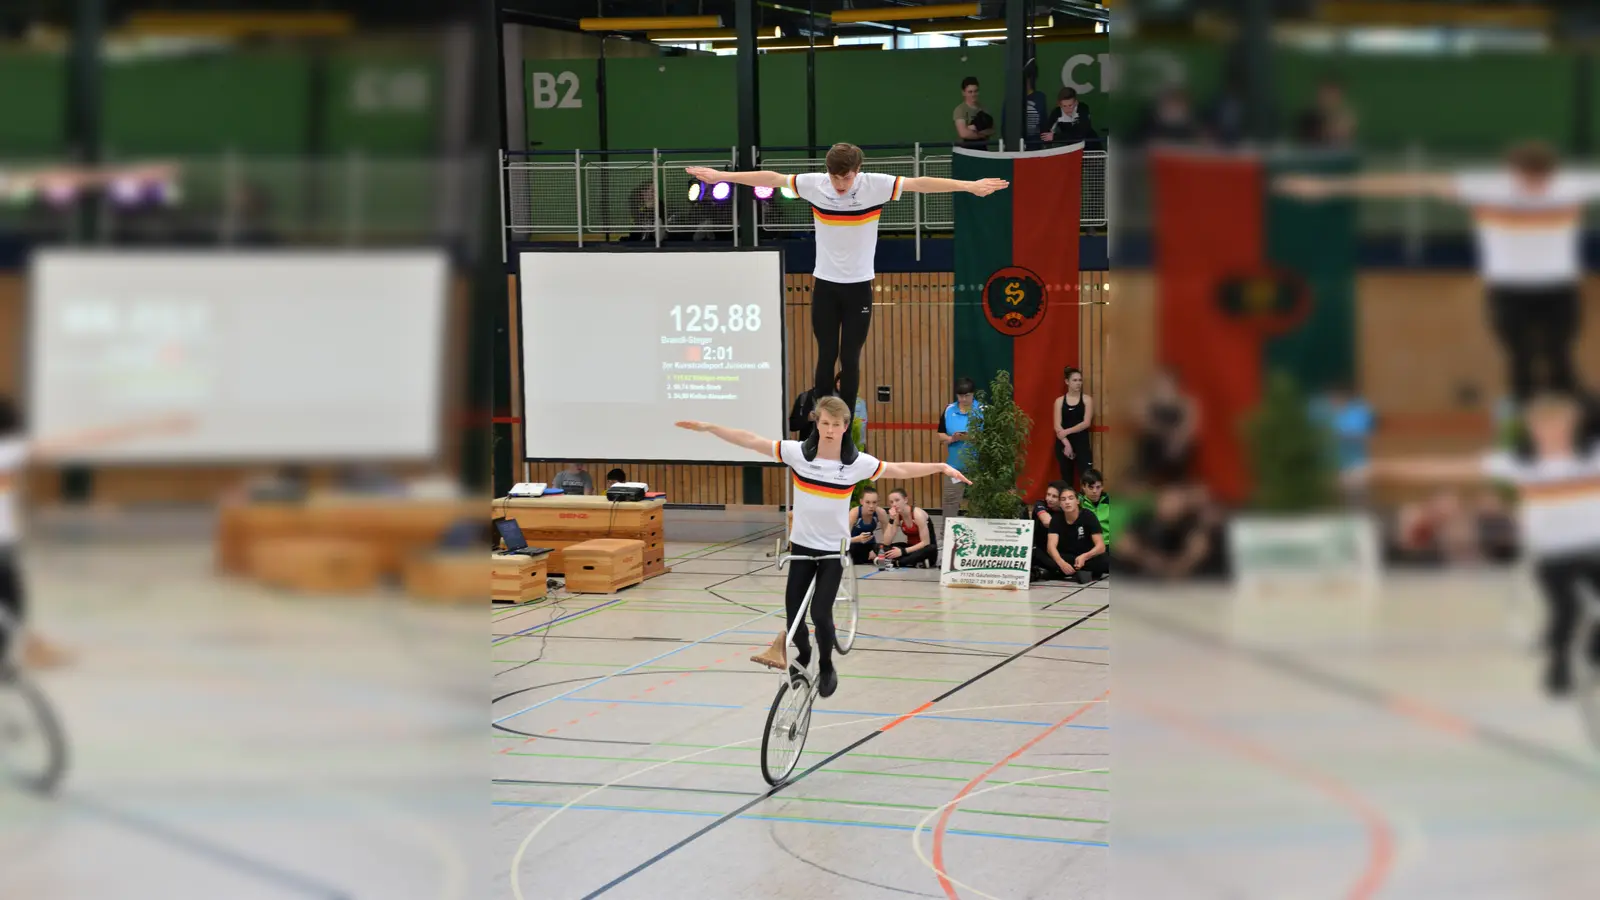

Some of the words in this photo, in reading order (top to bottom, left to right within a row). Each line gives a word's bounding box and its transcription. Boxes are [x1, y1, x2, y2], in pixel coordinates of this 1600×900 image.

[532, 70, 582, 109] B2
[670, 303, 761, 334] 125,88
[703, 346, 733, 360] 2:01
[976, 544, 1028, 558] KIENZLE
[960, 559, 1026, 569] BAUMSCHULEN
